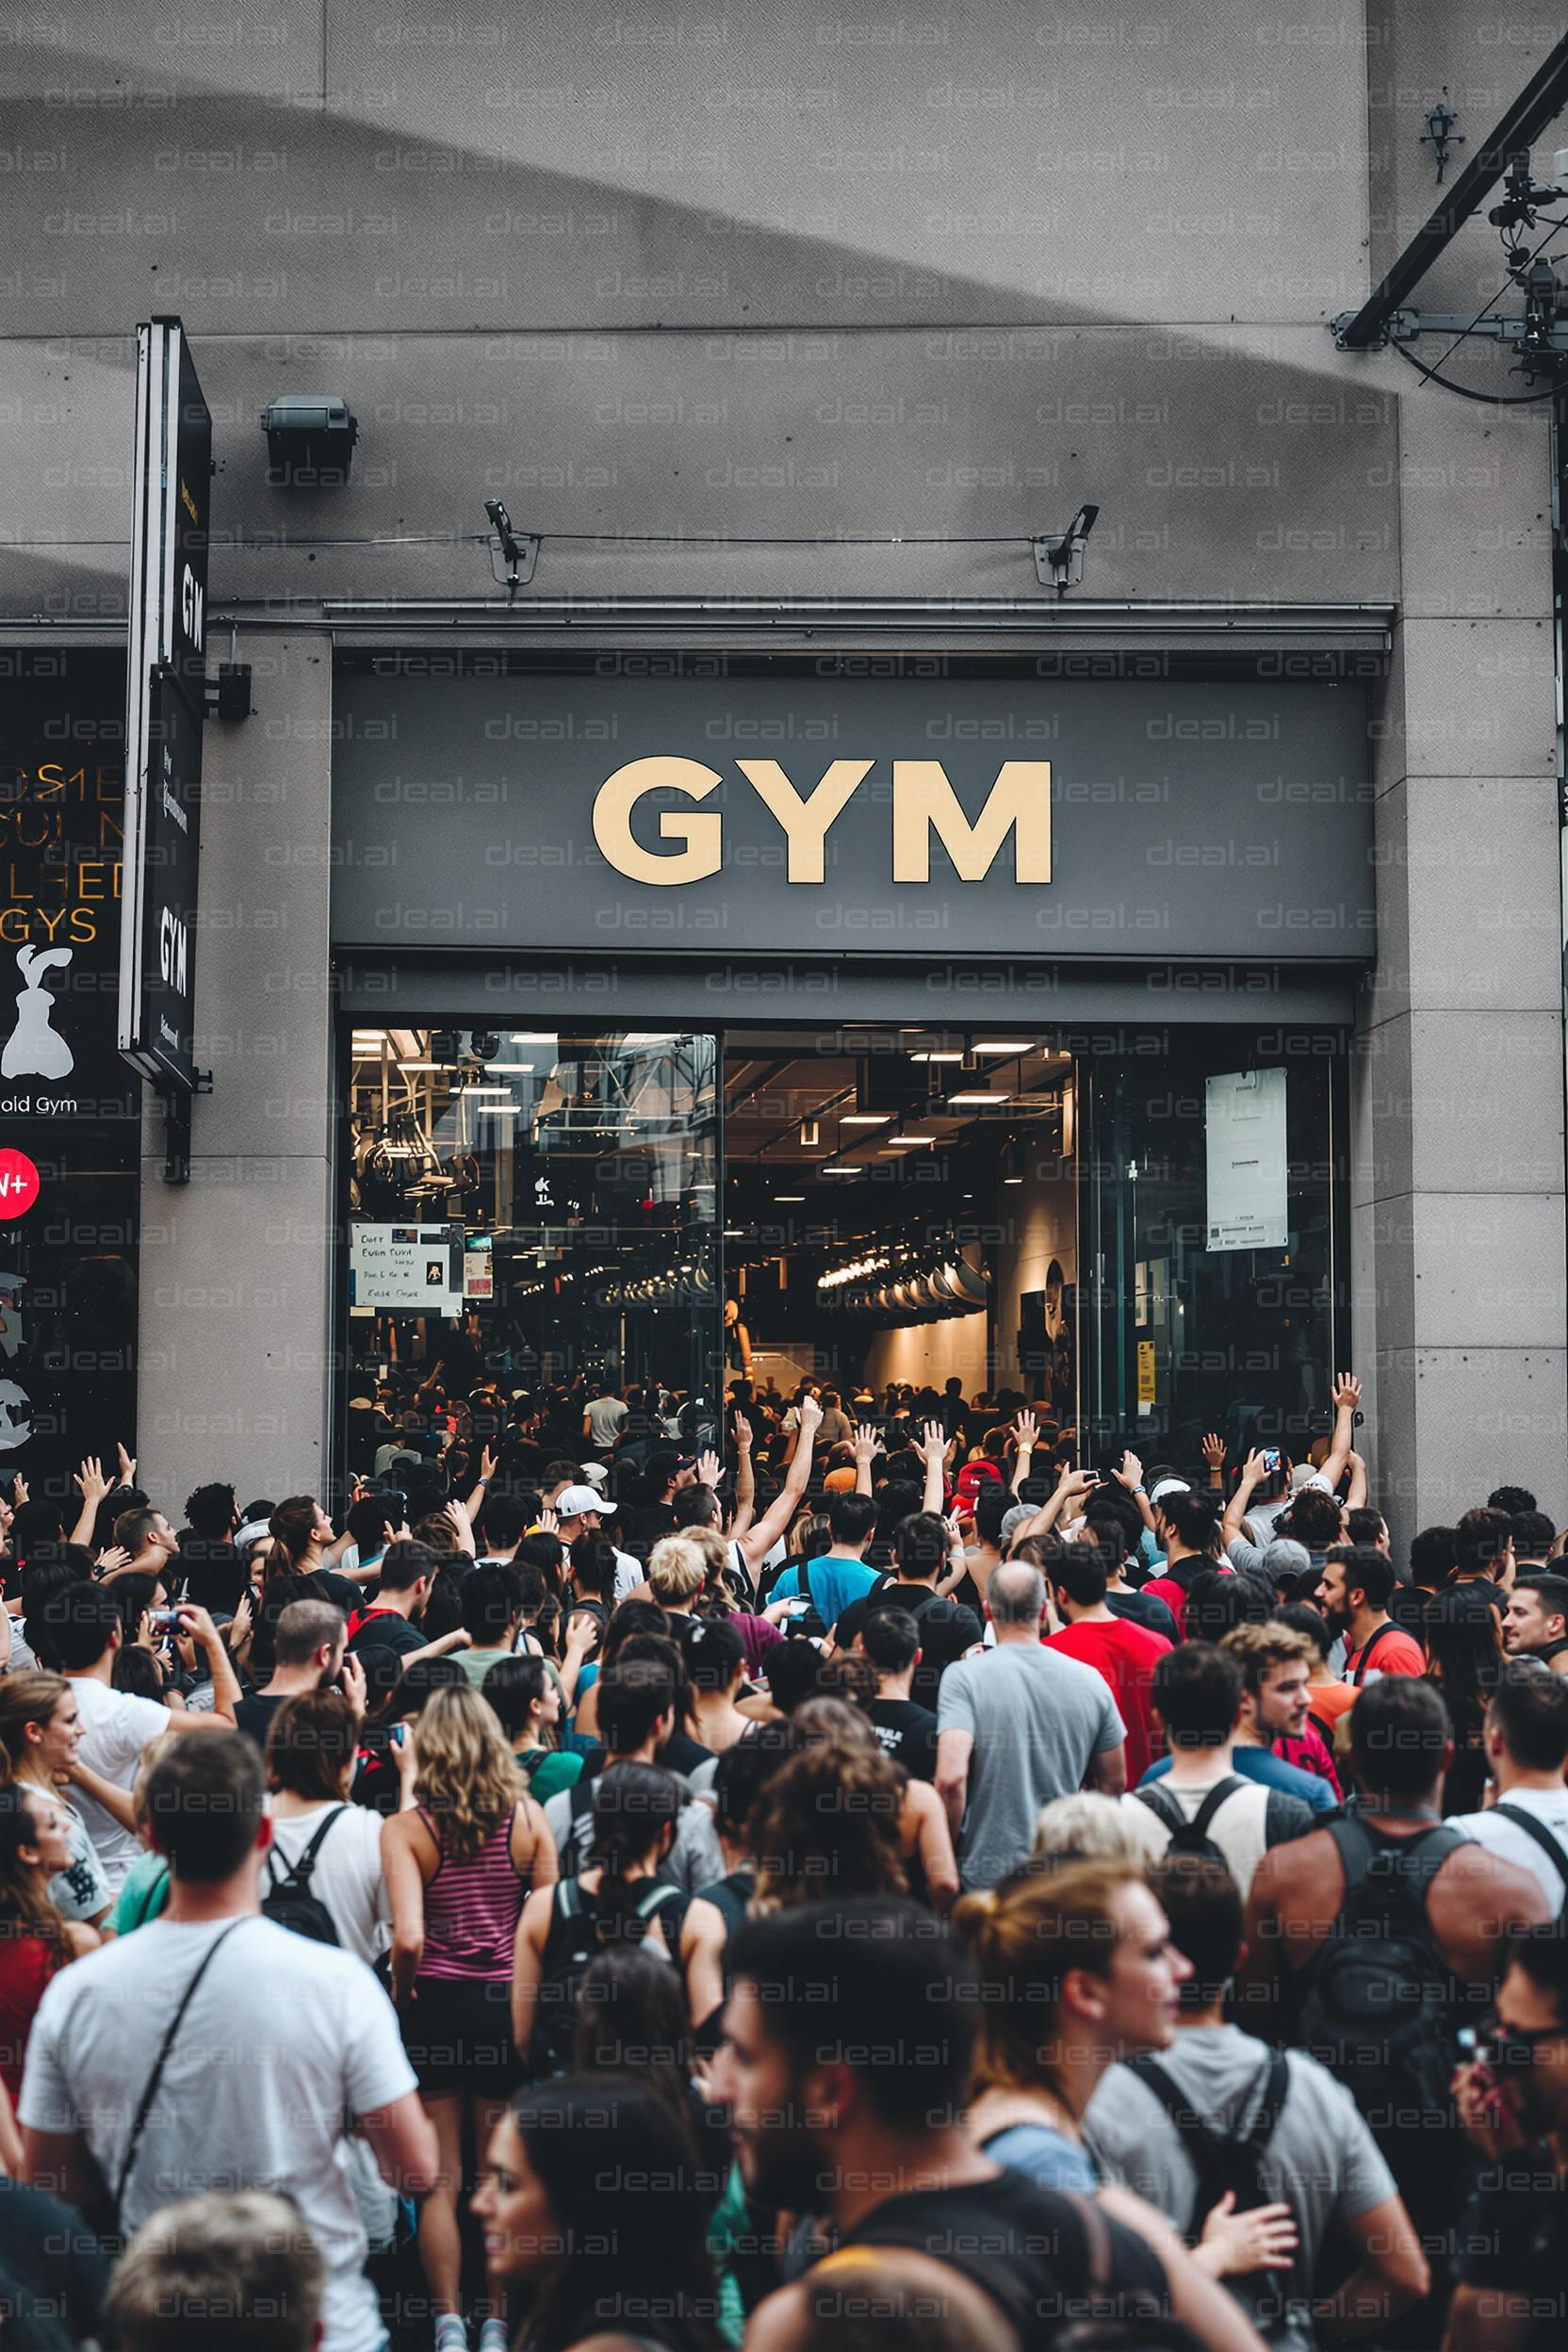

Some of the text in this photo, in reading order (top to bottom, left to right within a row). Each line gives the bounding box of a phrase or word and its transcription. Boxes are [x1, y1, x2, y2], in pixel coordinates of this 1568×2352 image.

[592, 755, 1052, 886] GYM
[0, 908, 96, 942] GYS
[160, 906, 187, 998] GYM
[36, 1097, 77, 1116] Gym
